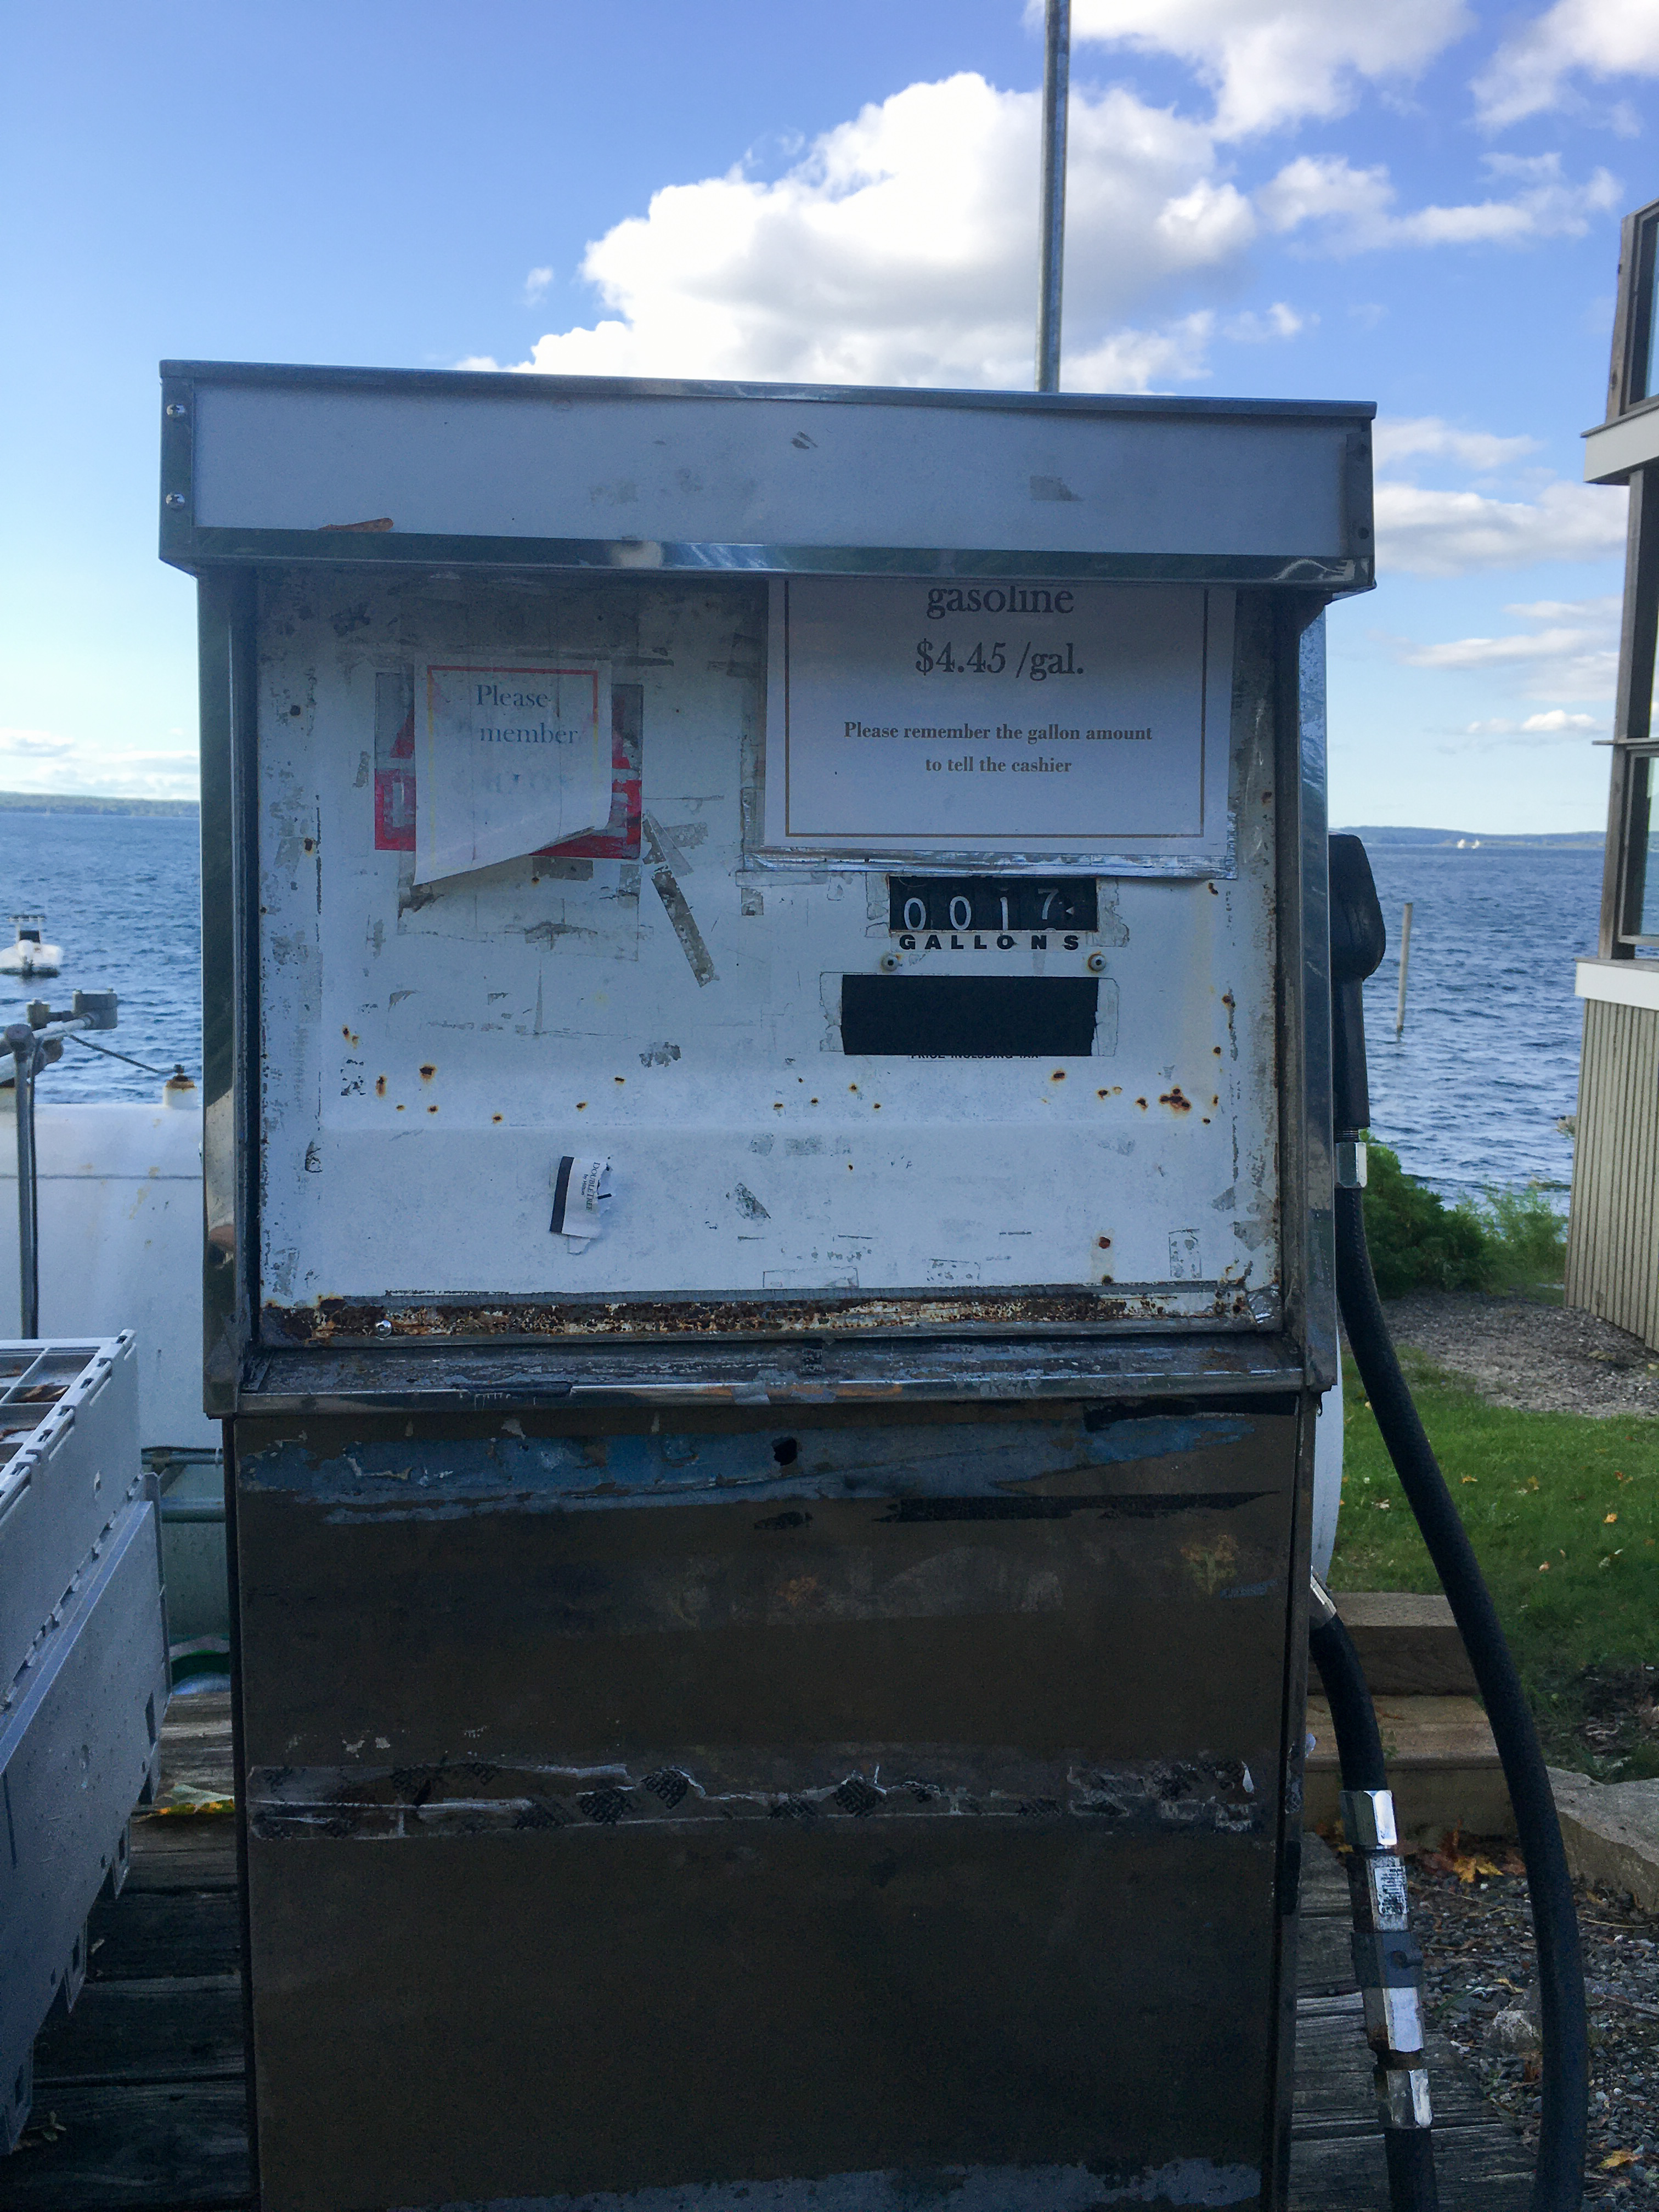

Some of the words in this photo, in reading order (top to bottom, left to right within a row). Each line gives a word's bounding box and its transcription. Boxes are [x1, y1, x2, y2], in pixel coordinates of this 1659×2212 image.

[926, 586, 1074, 619] gasoline
[916, 638, 1006, 676] $4.45
[1015, 642, 1084, 681] /gal.
[477, 684, 549, 708] Please
[844, 721, 899, 738] Please
[904, 723, 991, 739] remember
[996, 724, 1023, 740] the
[1028, 724, 1080, 745] gallon
[1086, 727, 1153, 740] amount
[926, 759, 942, 772] to
[947, 756, 974, 772] tell
[979, 756, 1006, 772] the
[1011, 757, 1072, 772] cashier
[899, 934, 1079, 951] GALLONS
